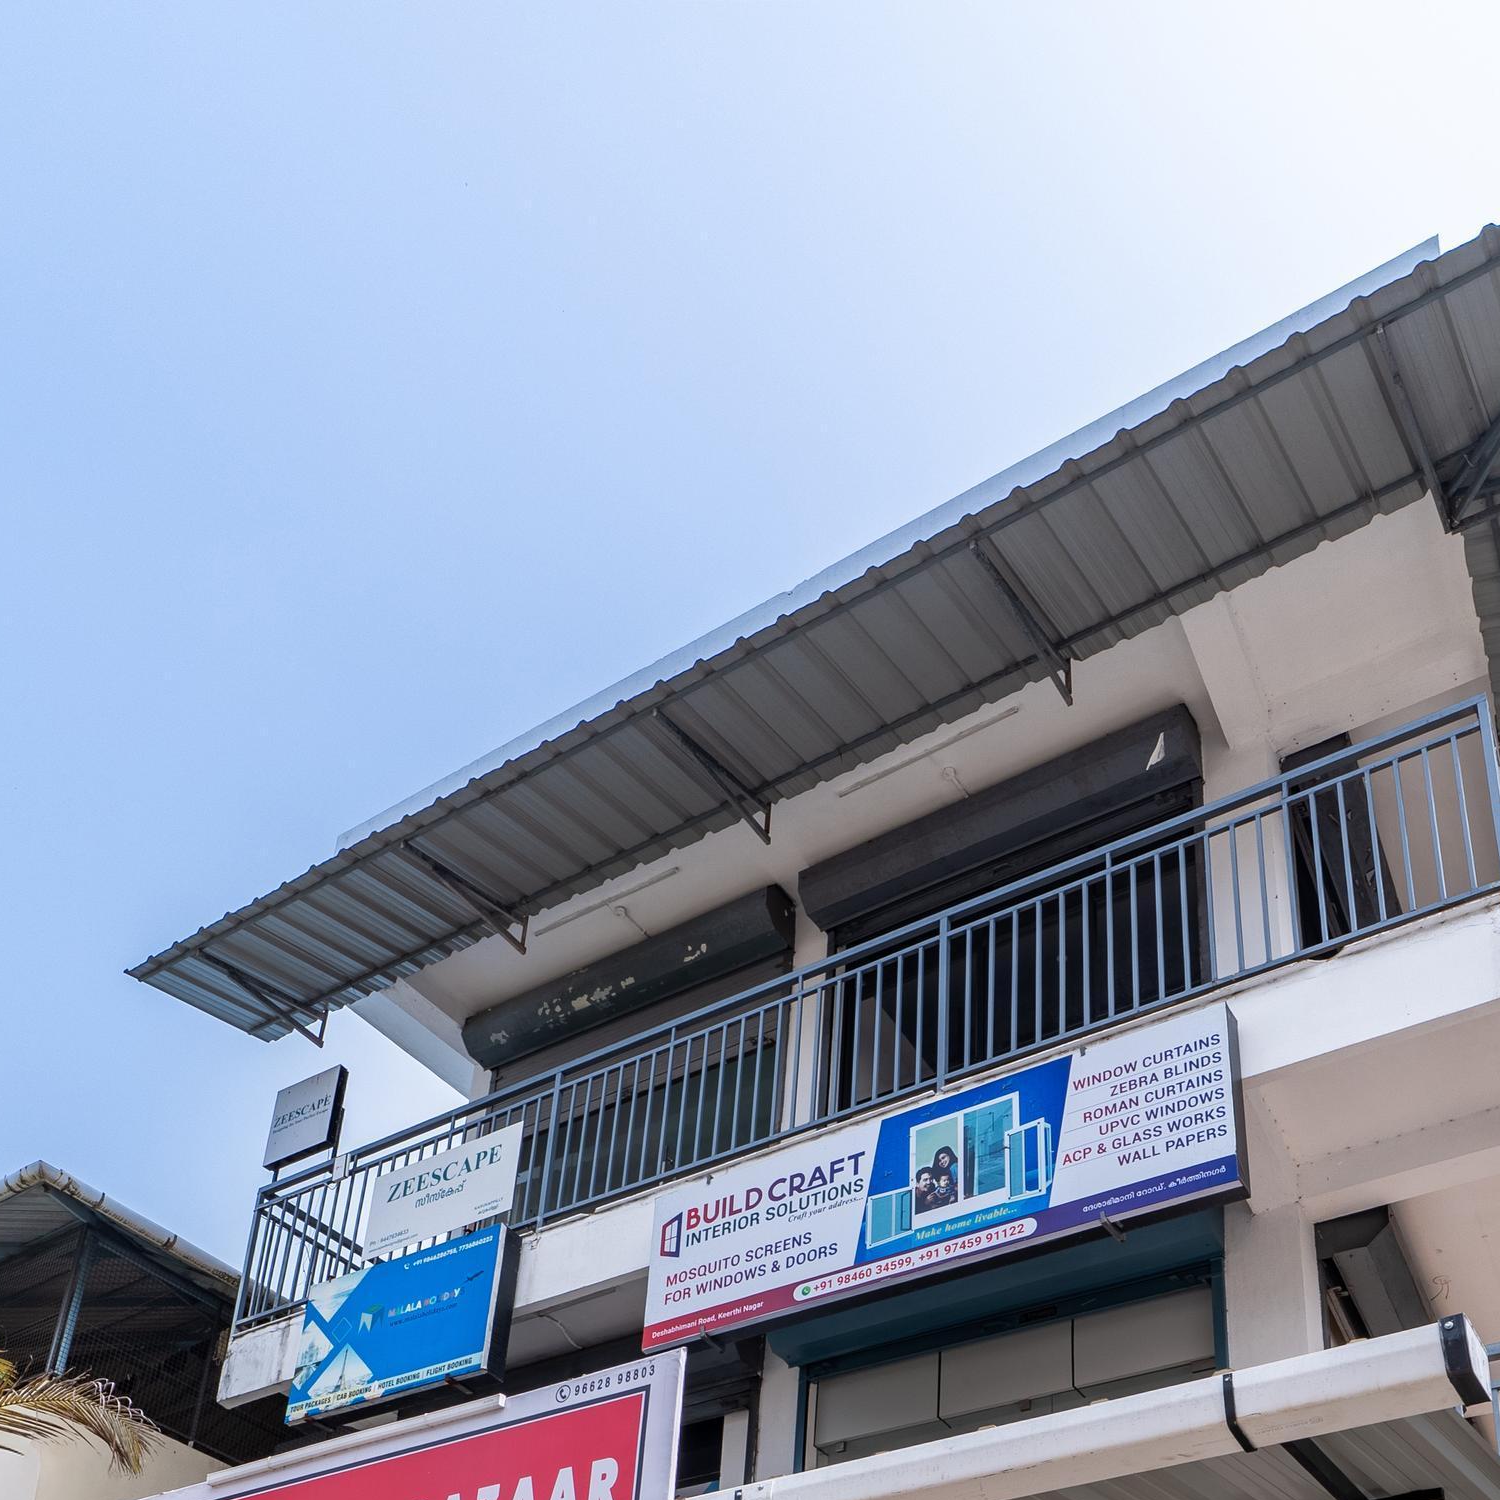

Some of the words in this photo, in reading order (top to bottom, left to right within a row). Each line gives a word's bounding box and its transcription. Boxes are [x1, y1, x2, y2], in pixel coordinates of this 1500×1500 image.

[1073, 1061, 1138, 1091] WINDOW
[1142, 1033, 1221, 1068] CURTAINS
[1110, 1072, 1159, 1097] ZEBRA
[1164, 1051, 1222, 1079] BLINDS
[273, 1095, 331, 1128] ZEESCAPE
[1083, 1096, 1139, 1123] ROMAN
[1144, 1069, 1223, 1103] CURTAINS
[1099, 1114, 1140, 1136] UPVC
[1145, 1087, 1225, 1121] WINDOWS
[1062, 1147, 1092, 1165] ACP
[1097, 1143, 1107, 1155] &
[1112, 1125, 1162, 1150] GLASS
[1167, 1106, 1226, 1132] WORKS
[1117, 1145, 1160, 1166] WALL
[1165, 1124, 1228, 1153] PAPERS
[386, 1144, 502, 1203] ZEESCAPE
[686, 1187, 763, 1230] BUILD
[768, 1151, 865, 1201] CRAFT
[685, 1211, 759, 1247] INTERIOR
[765, 1178, 864, 1221] SOLUTIONS
[788, 1211, 807, 1223] Craft
[808, 1206, 826, 1217] your
[915, 1227, 942, 1241] Make
[945, 1218, 972, 1233] home
[664, 1287, 691, 1305] FOR
[696, 1264, 766, 1296] WINDOWS
[771, 1260, 781, 1273] &
[785, 1242, 838, 1268] DOORS
[666, 1254, 740, 1287] MOSQUITO
[745, 1232, 812, 1262] SCREENS
[813, 1280, 833, 1293] +91
[837, 1267, 872, 1287] 98460
[875, 1256, 915, 1276] 34599,
[918, 1248, 940, 1261] +91
[944, 1235, 982, 1255] 97459
[986, 1223, 1025, 1243] 91122
[651, 1320, 697, 1339] Deshabhimani
[718, 1307, 742, 1320] Keerthi
[743, 1301, 764, 1313] Nagar
[290, 1403, 304, 1413] TOUR
[304, 1396, 331, 1409] PACKAGES
[336, 1392, 348, 1402] CAB
[348, 1386, 372, 1398] BOOKING
[377, 1380, 394, 1390] HOTEL
[396, 1373, 420, 1386] BOOKING
[426, 1366, 446, 1377] FLIGHT
[447, 1357, 473, 1372] BOOKING
[574, 1377, 611, 1396] 96628
[617, 1364, 655, 1385] 98803
